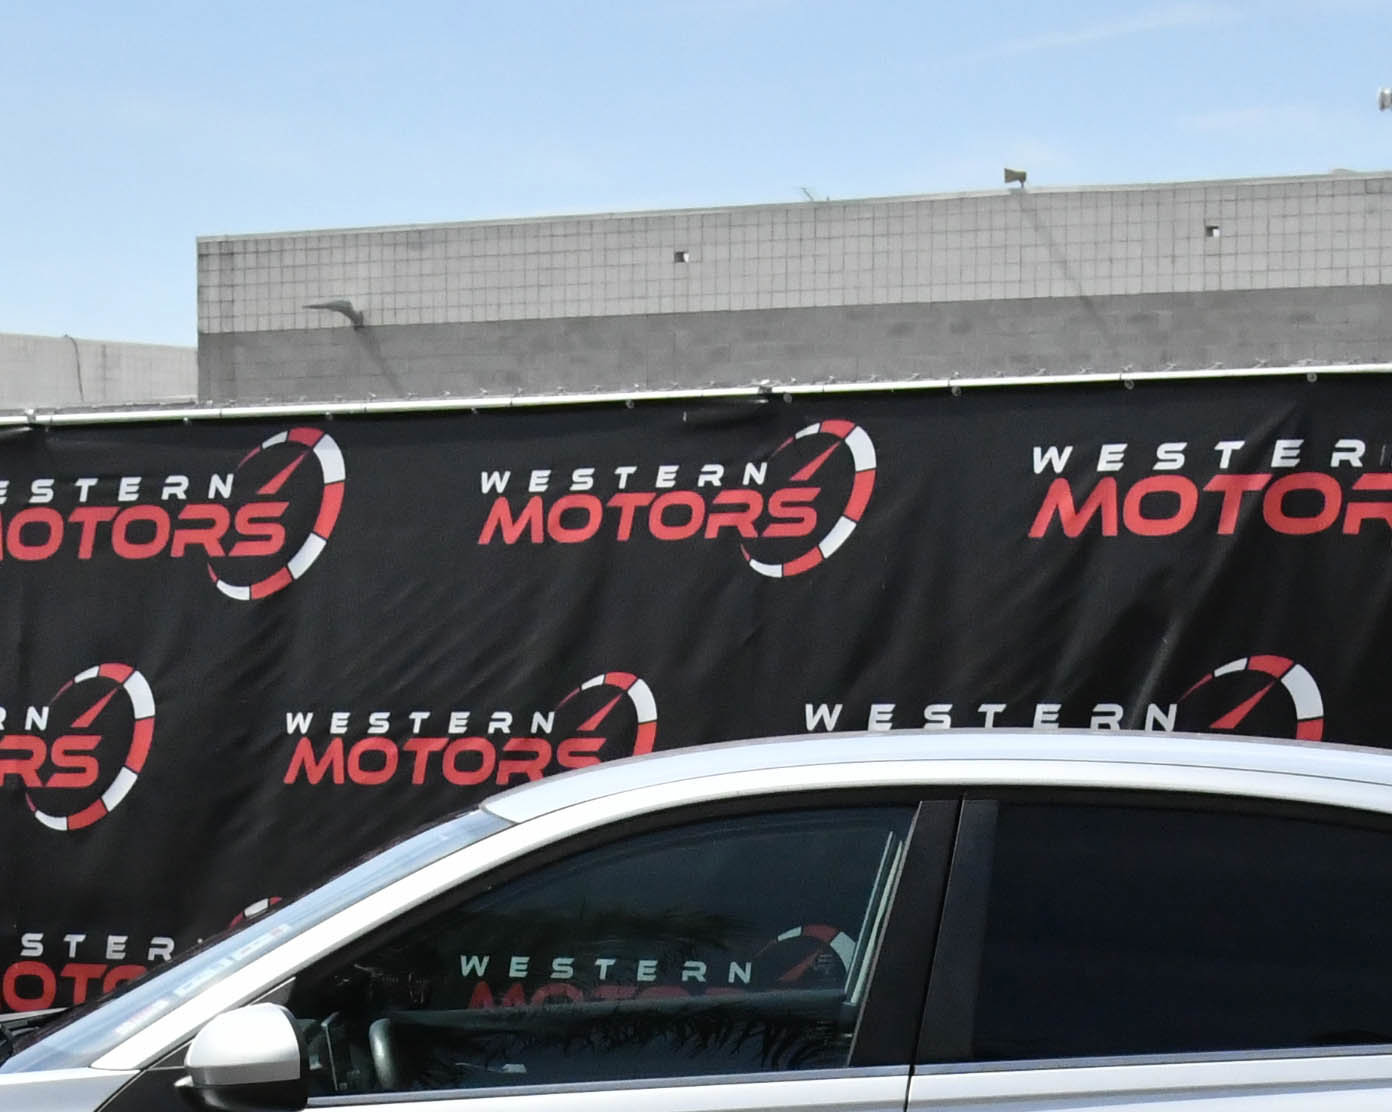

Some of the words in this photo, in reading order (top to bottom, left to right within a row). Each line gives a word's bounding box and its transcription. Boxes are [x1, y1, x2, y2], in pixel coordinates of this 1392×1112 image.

[481, 462, 767, 494] WESTERN
[480, 487, 820, 545] MOTORS
[286, 712, 555, 734] WESTERN
[805, 703, 1177, 732] WESTERN
[284, 736, 606, 786] MOTORS
[461, 956, 751, 983] WESTERN
